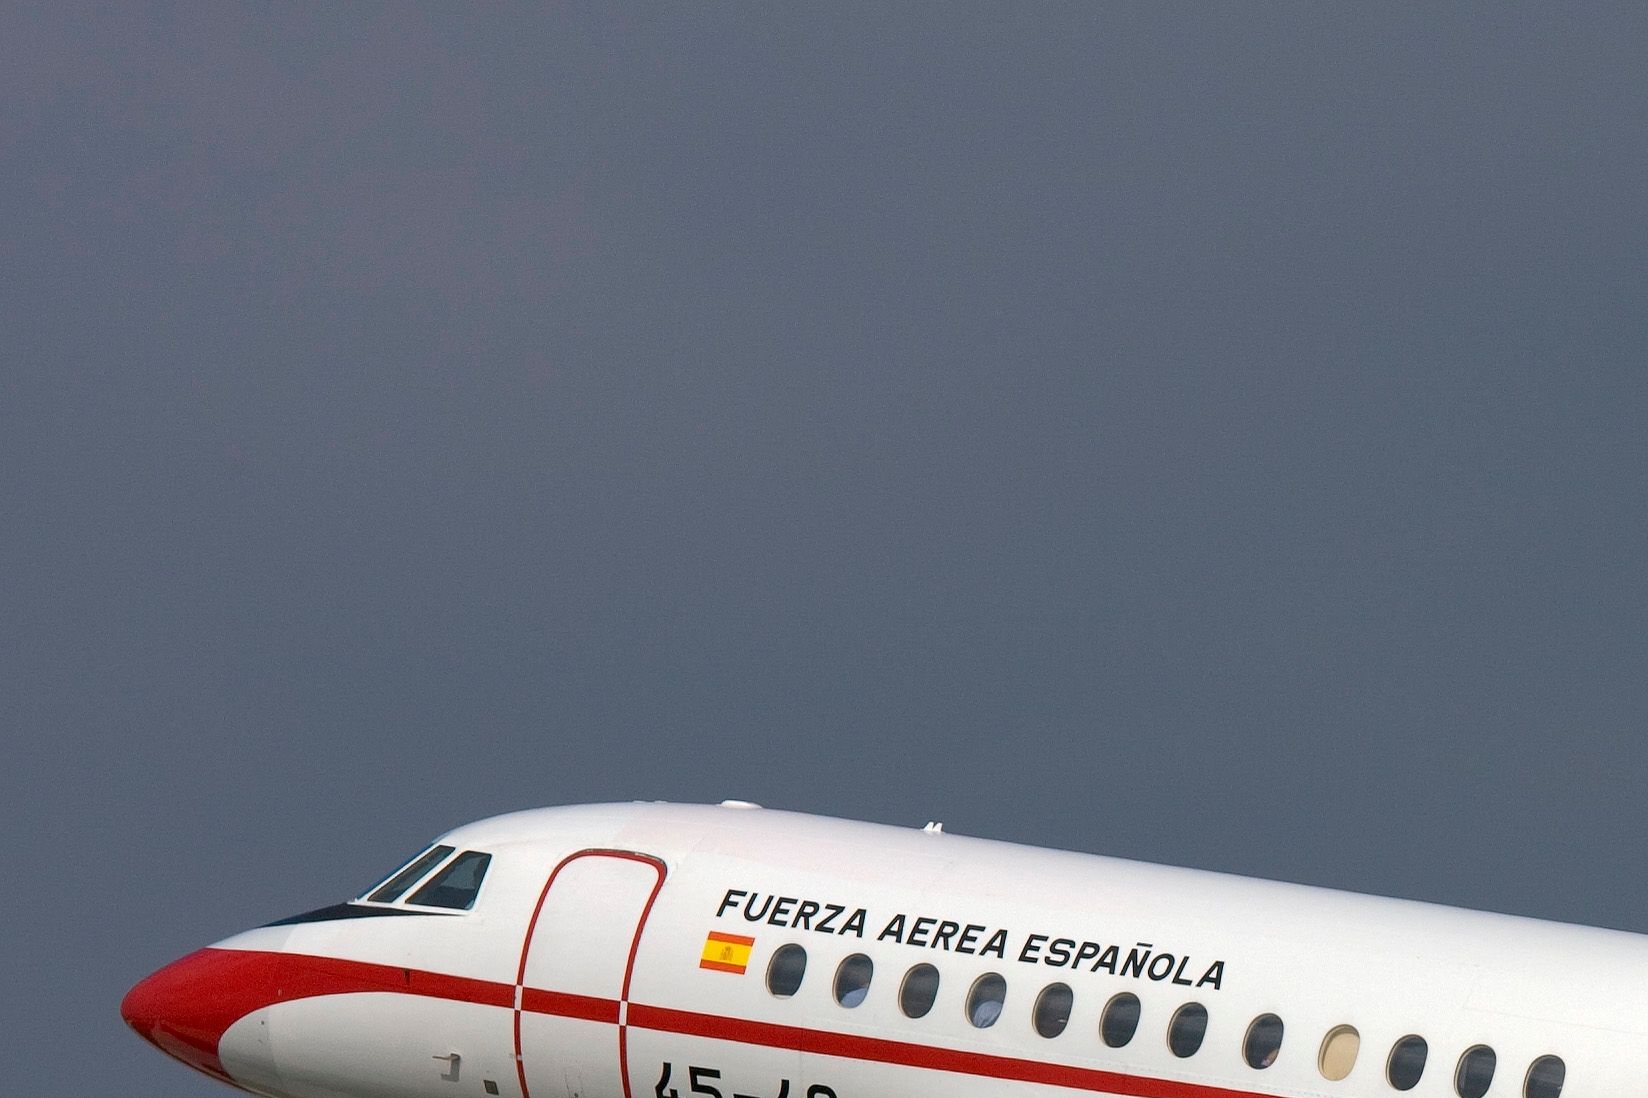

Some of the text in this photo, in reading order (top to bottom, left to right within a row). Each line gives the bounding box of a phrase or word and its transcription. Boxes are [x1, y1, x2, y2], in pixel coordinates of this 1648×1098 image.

[716, 889, 1225, 991] FUERZA AEREA ESPAÑOLA
